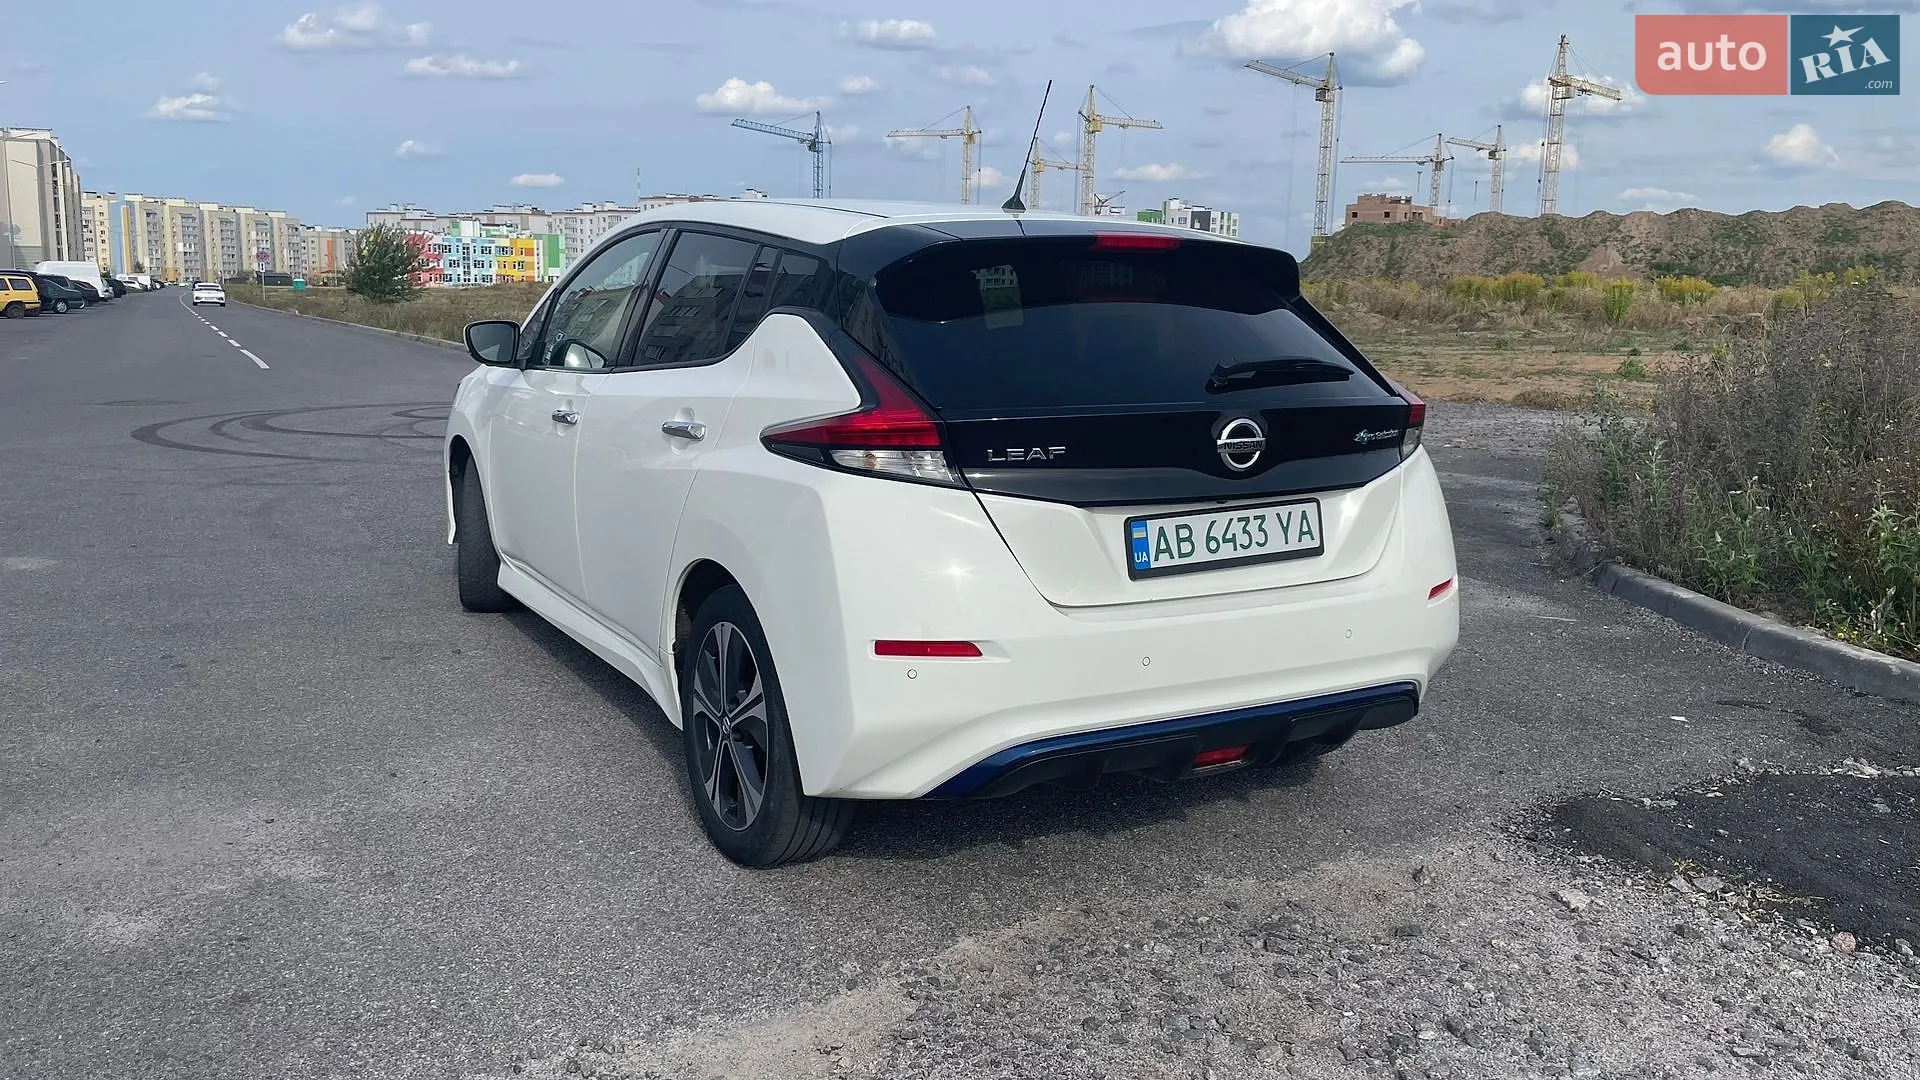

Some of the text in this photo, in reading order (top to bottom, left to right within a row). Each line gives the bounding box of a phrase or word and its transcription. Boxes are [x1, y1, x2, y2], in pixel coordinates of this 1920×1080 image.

[1223, 441, 1263, 450] NISSAN
[987, 446, 1066, 461] LEAF
[1153, 510, 1316, 562] AB 6433 YA
[1134, 551, 1149, 563] UA
